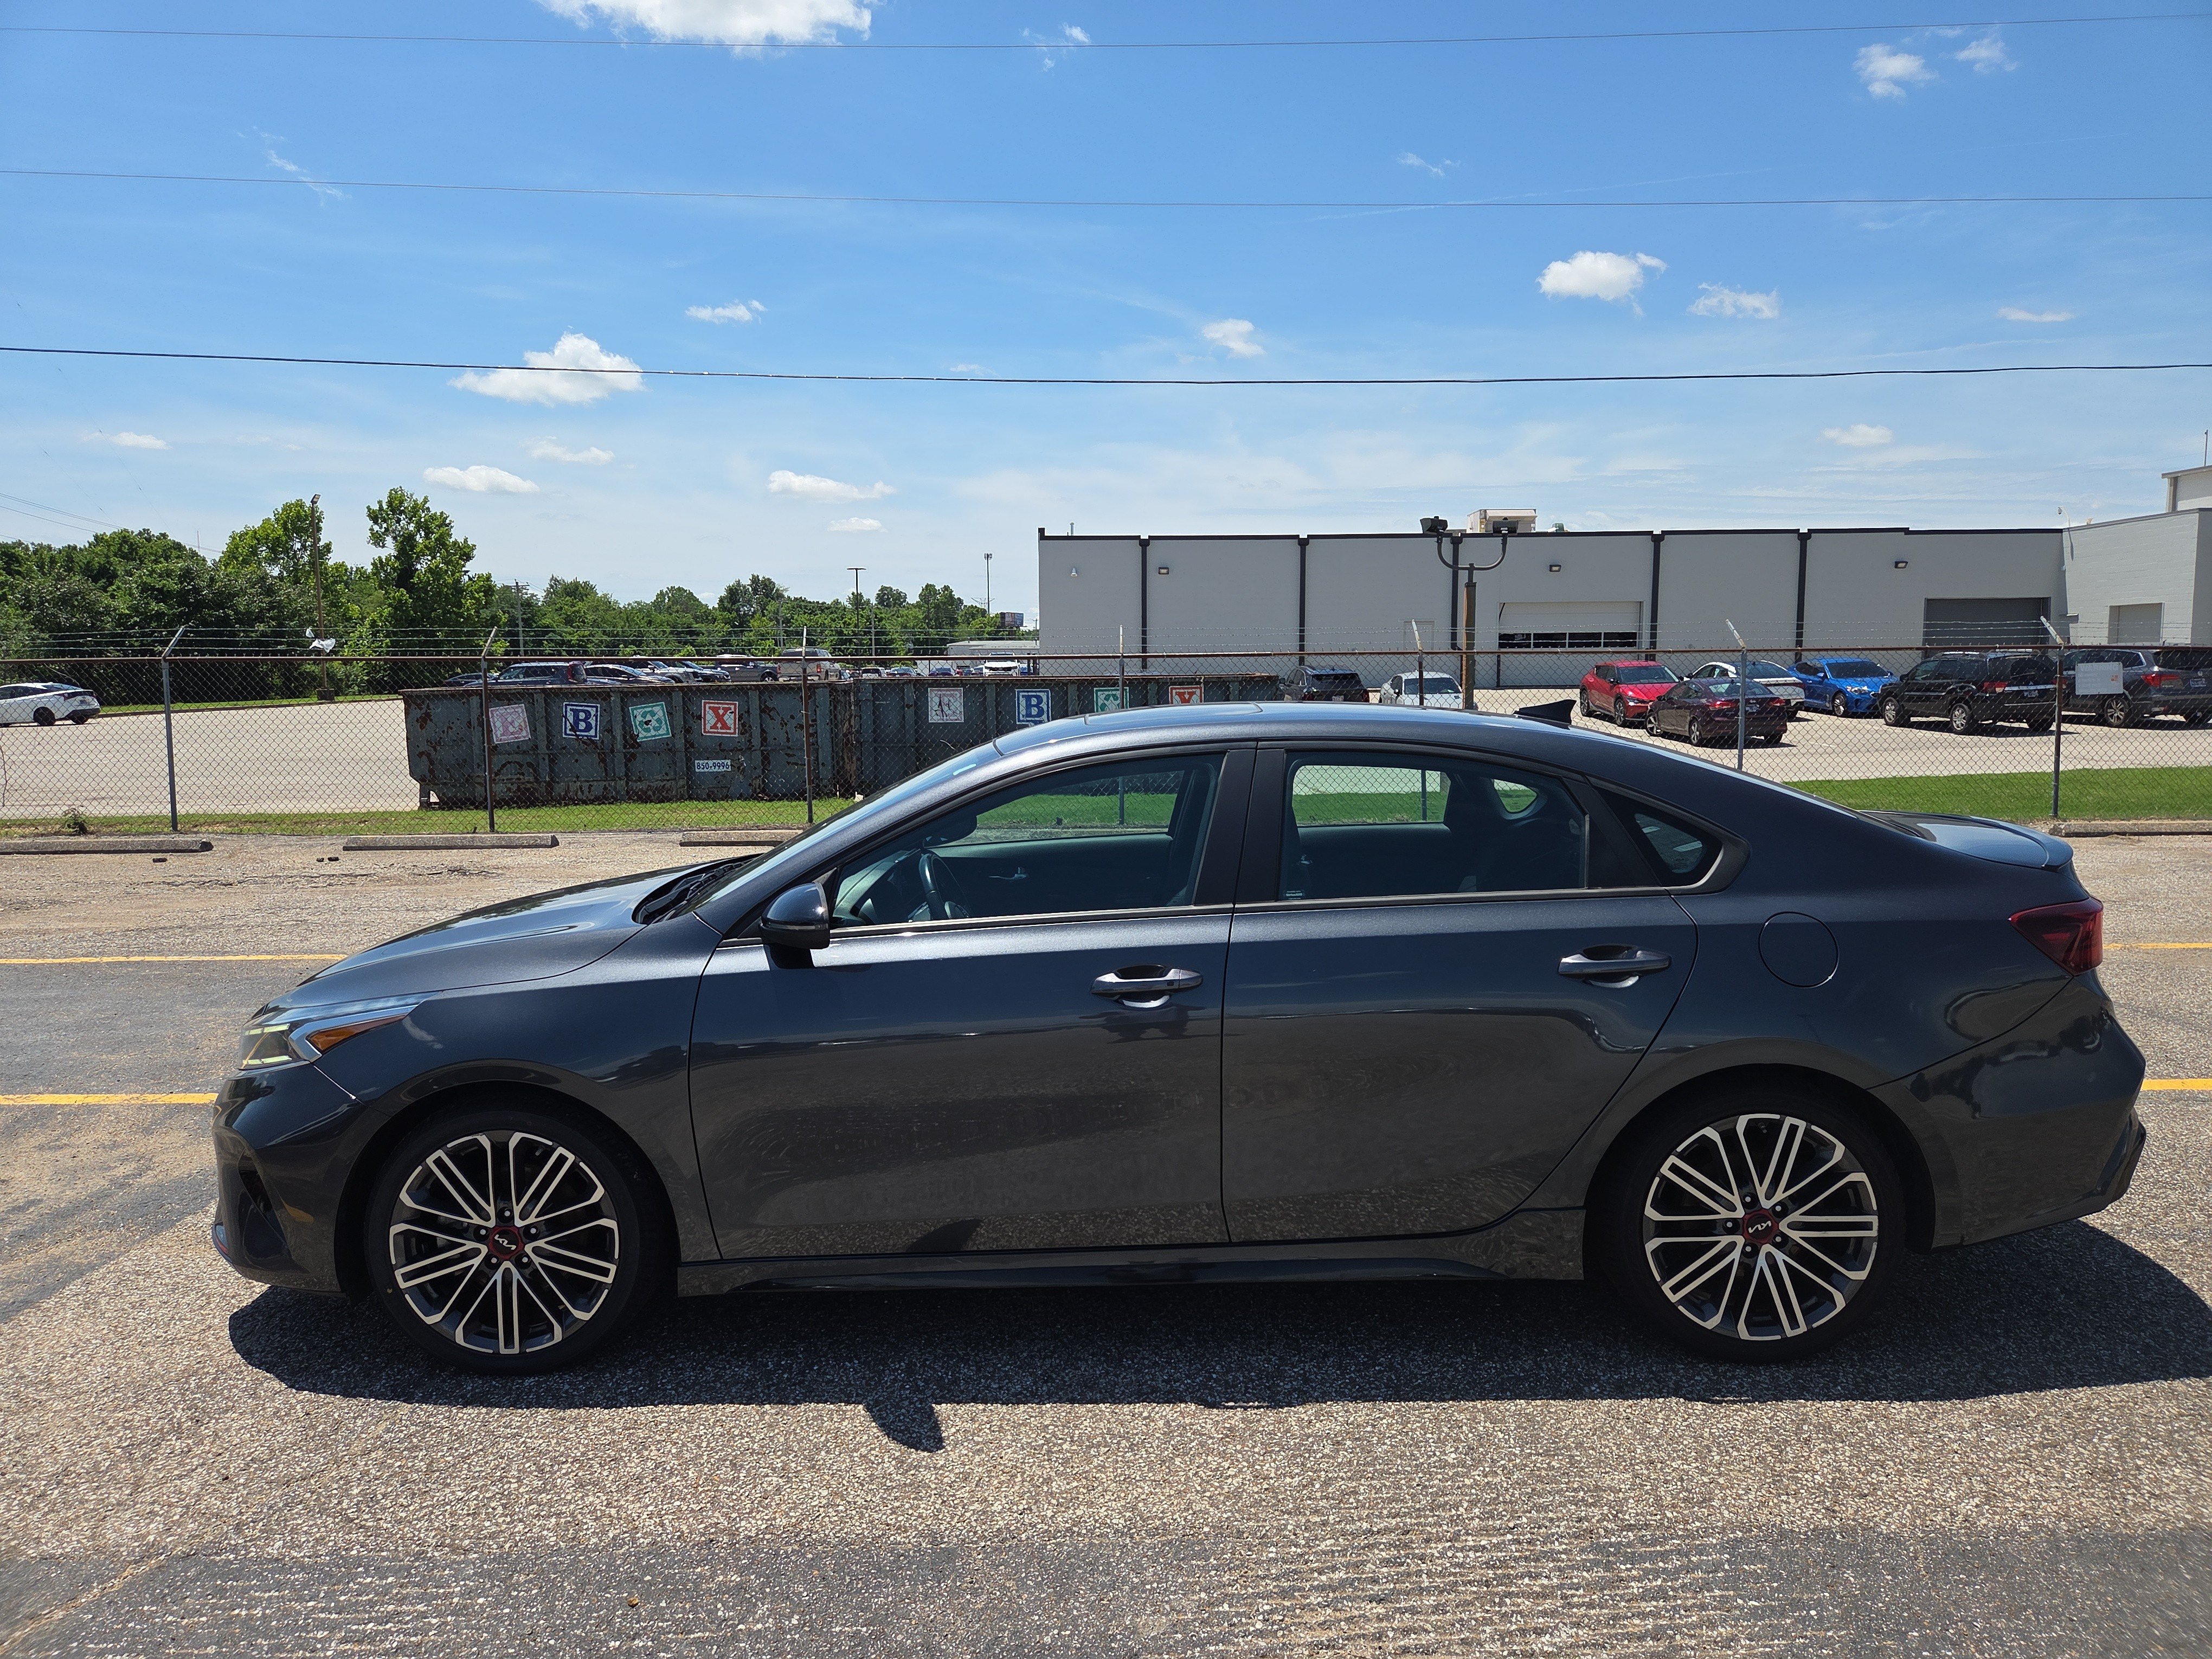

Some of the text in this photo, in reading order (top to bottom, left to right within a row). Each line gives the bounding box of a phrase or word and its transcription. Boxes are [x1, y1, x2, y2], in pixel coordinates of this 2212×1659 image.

[1022, 695, 1045, 718] B
[569, 708, 593, 732] B
[708, 706, 732, 730] X
[696, 761, 730, 770] 850-9996
